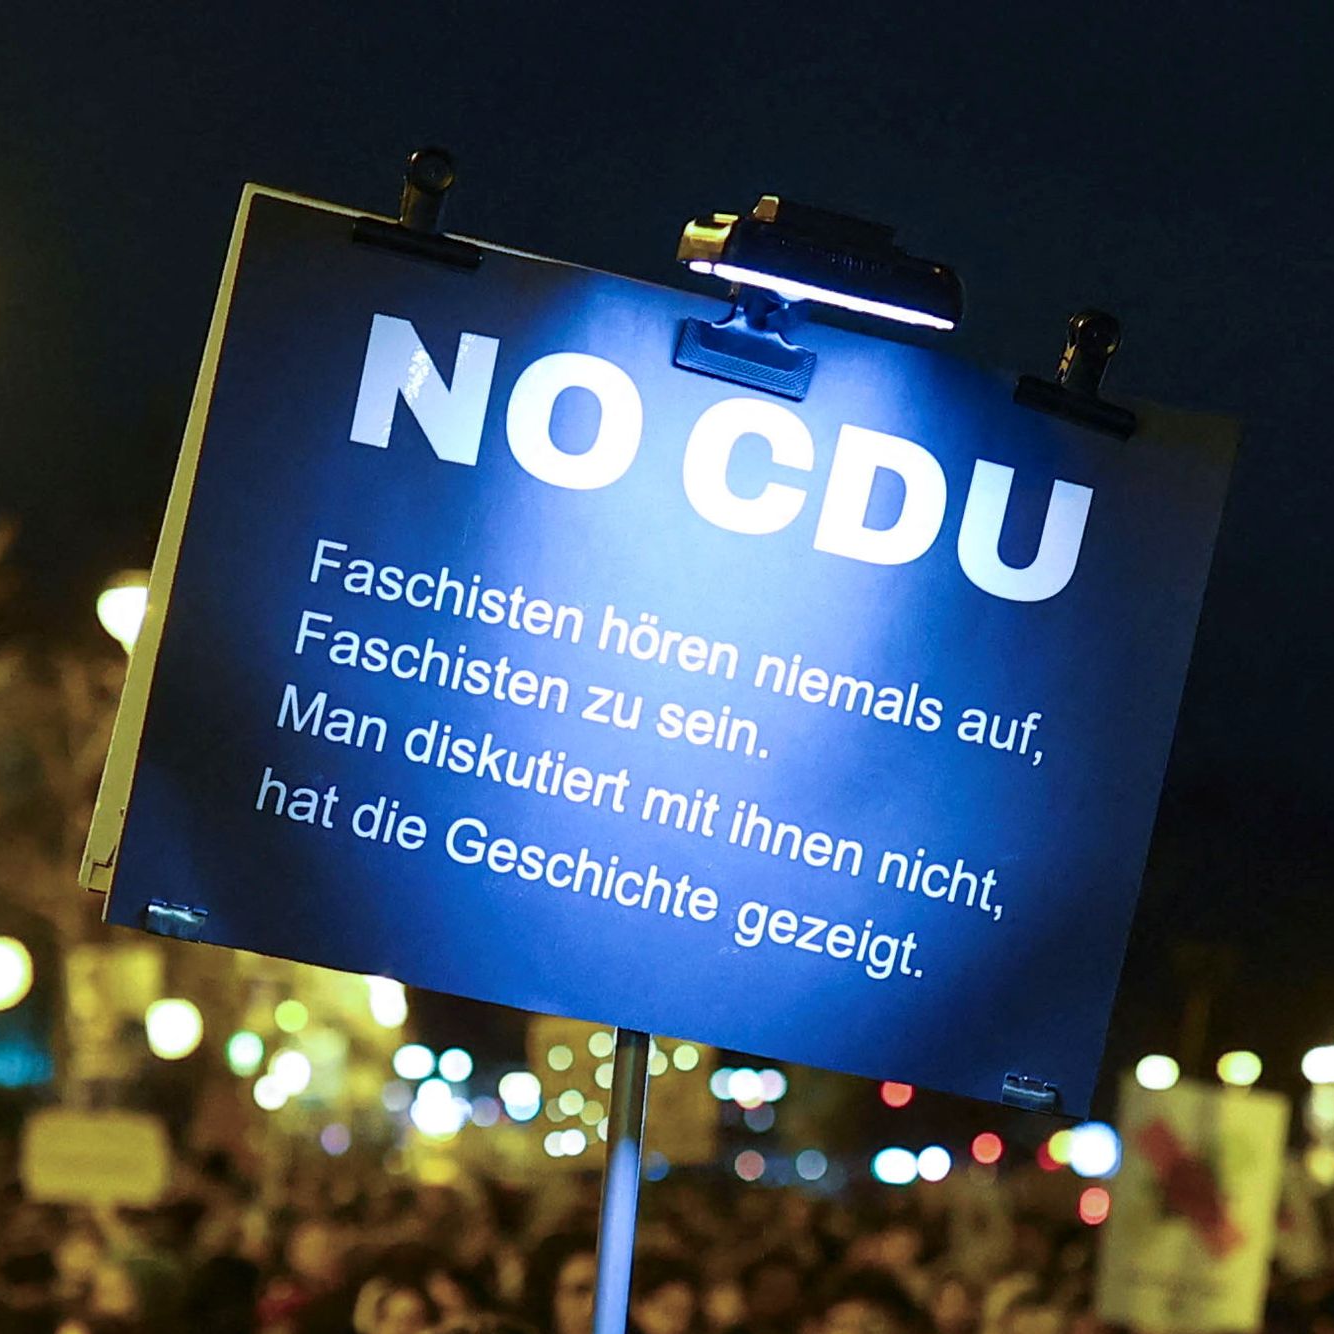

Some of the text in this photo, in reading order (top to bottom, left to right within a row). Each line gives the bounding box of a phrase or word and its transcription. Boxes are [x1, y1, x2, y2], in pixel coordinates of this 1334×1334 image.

[349, 313, 1094, 602] NO CDU
[295, 609, 770, 759] Faschisten zu sein.
[310, 537, 1044, 766] Faschisten hören niemals auf,
[255, 767, 924, 980] hat die Geschichte gezeigt.
[277, 684, 1004, 921] Man diskutiert mit ihnen nicht,
